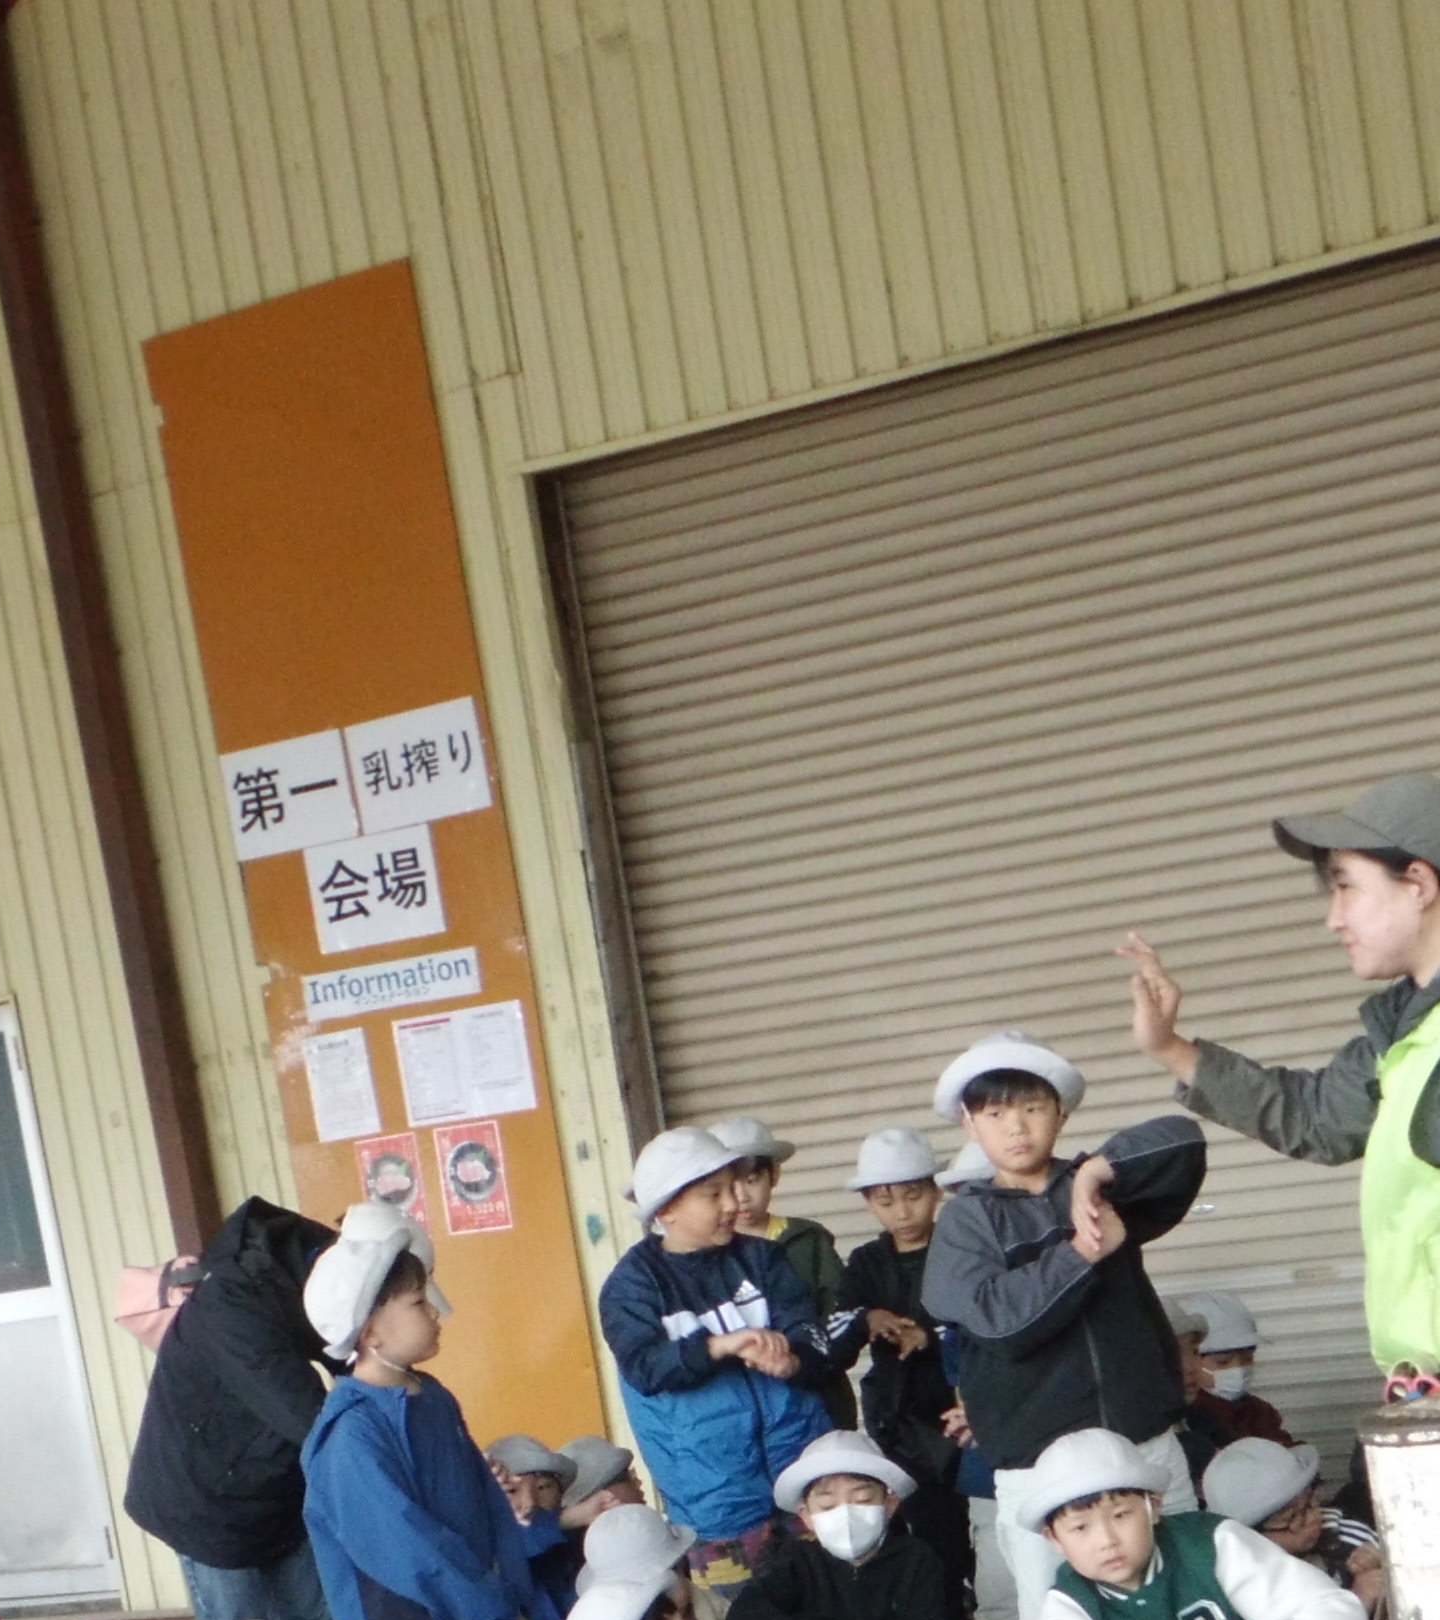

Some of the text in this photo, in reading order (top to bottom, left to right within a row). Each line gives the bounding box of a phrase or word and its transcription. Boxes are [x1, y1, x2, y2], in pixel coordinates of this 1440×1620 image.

[232, 730, 472, 833] 第一 乳搾り
[318, 847, 428, 924] 会場
[309, 958, 471, 1005] Information
